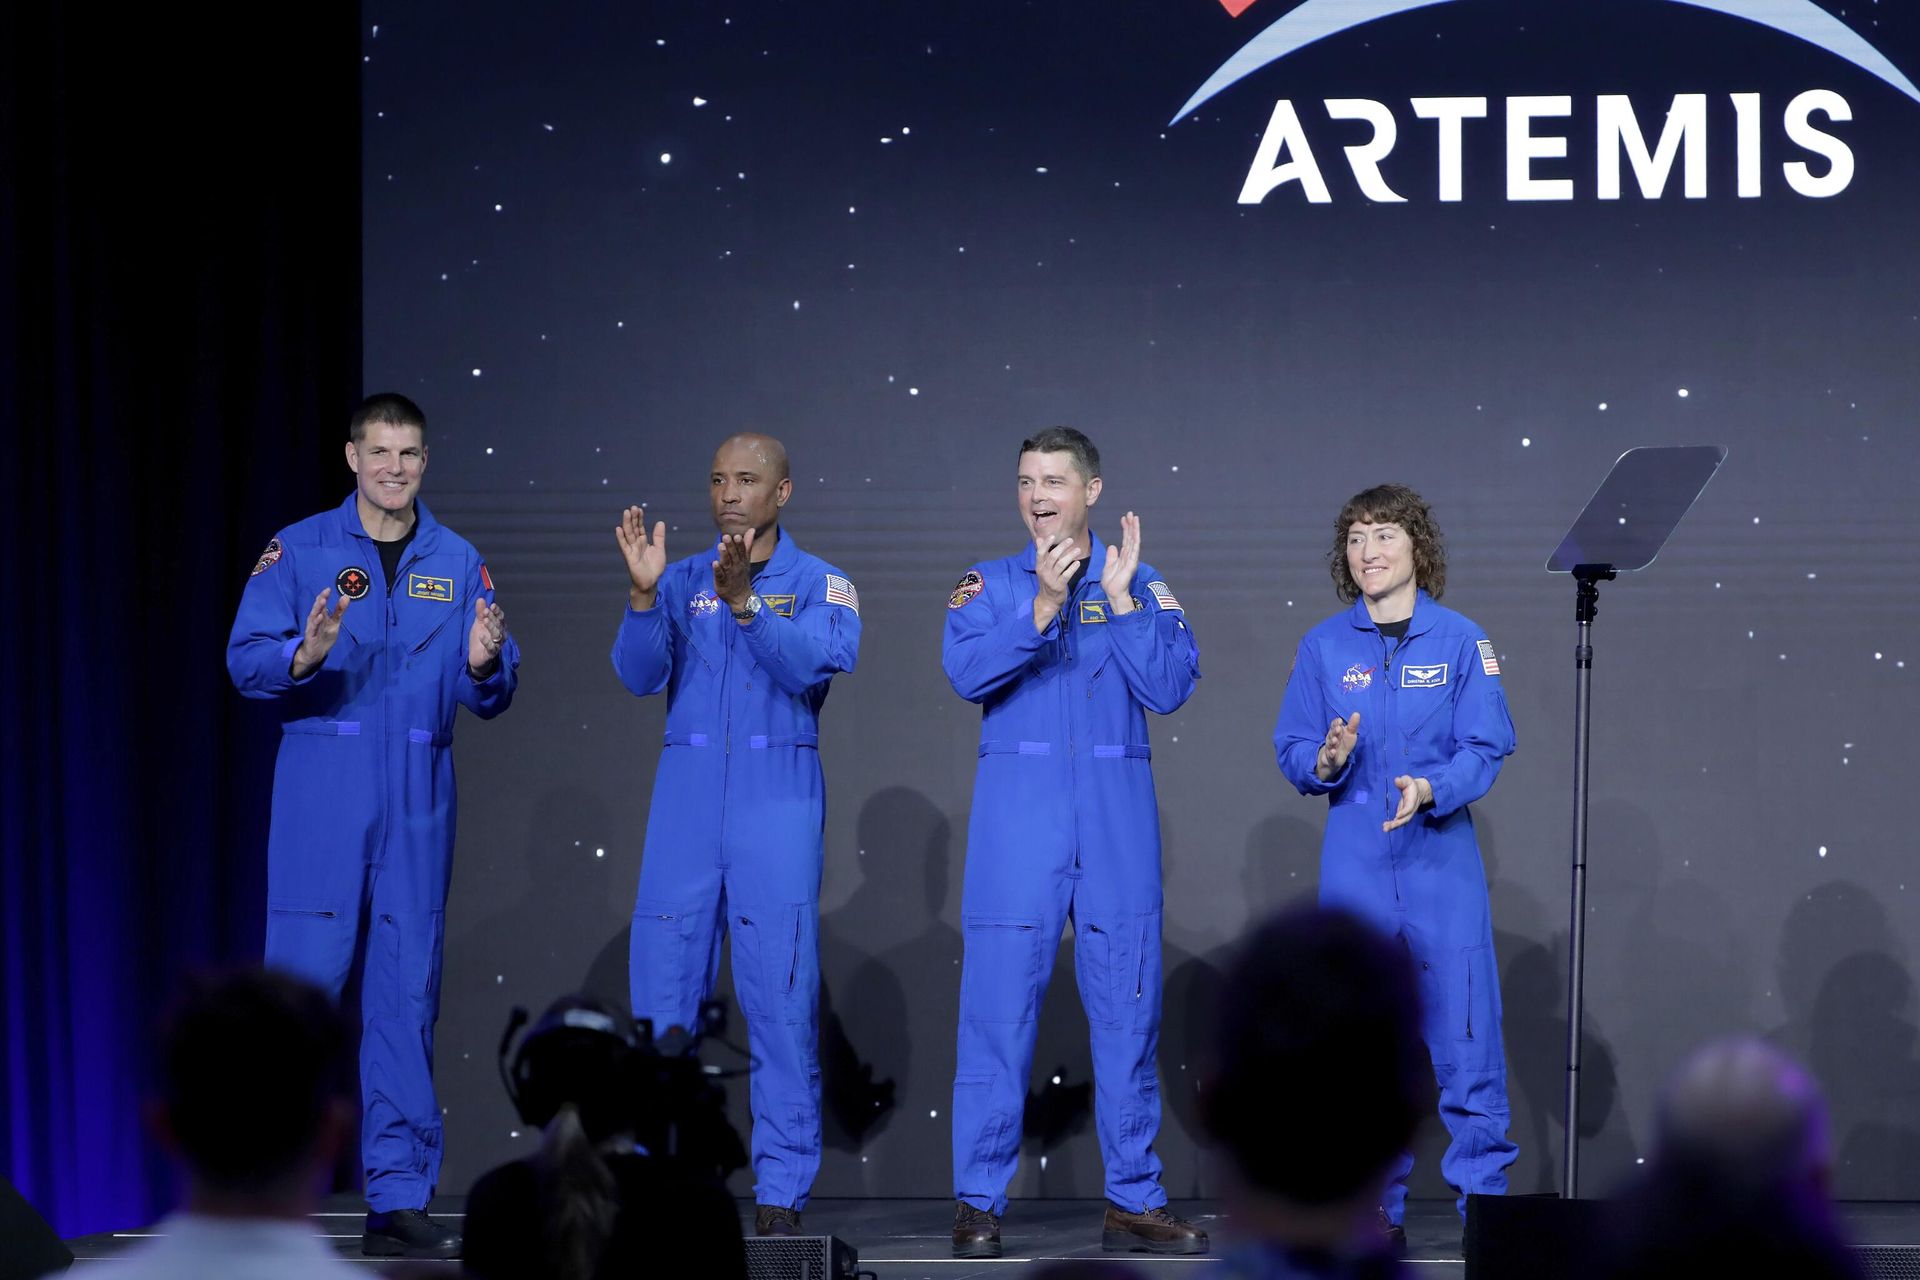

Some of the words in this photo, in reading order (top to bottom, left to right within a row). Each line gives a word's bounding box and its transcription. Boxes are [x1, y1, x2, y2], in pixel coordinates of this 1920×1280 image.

[1237, 89, 1855, 204] ARTEMIS
[690, 600, 718, 610] NASA
[1343, 673, 1372, 684] NASA
